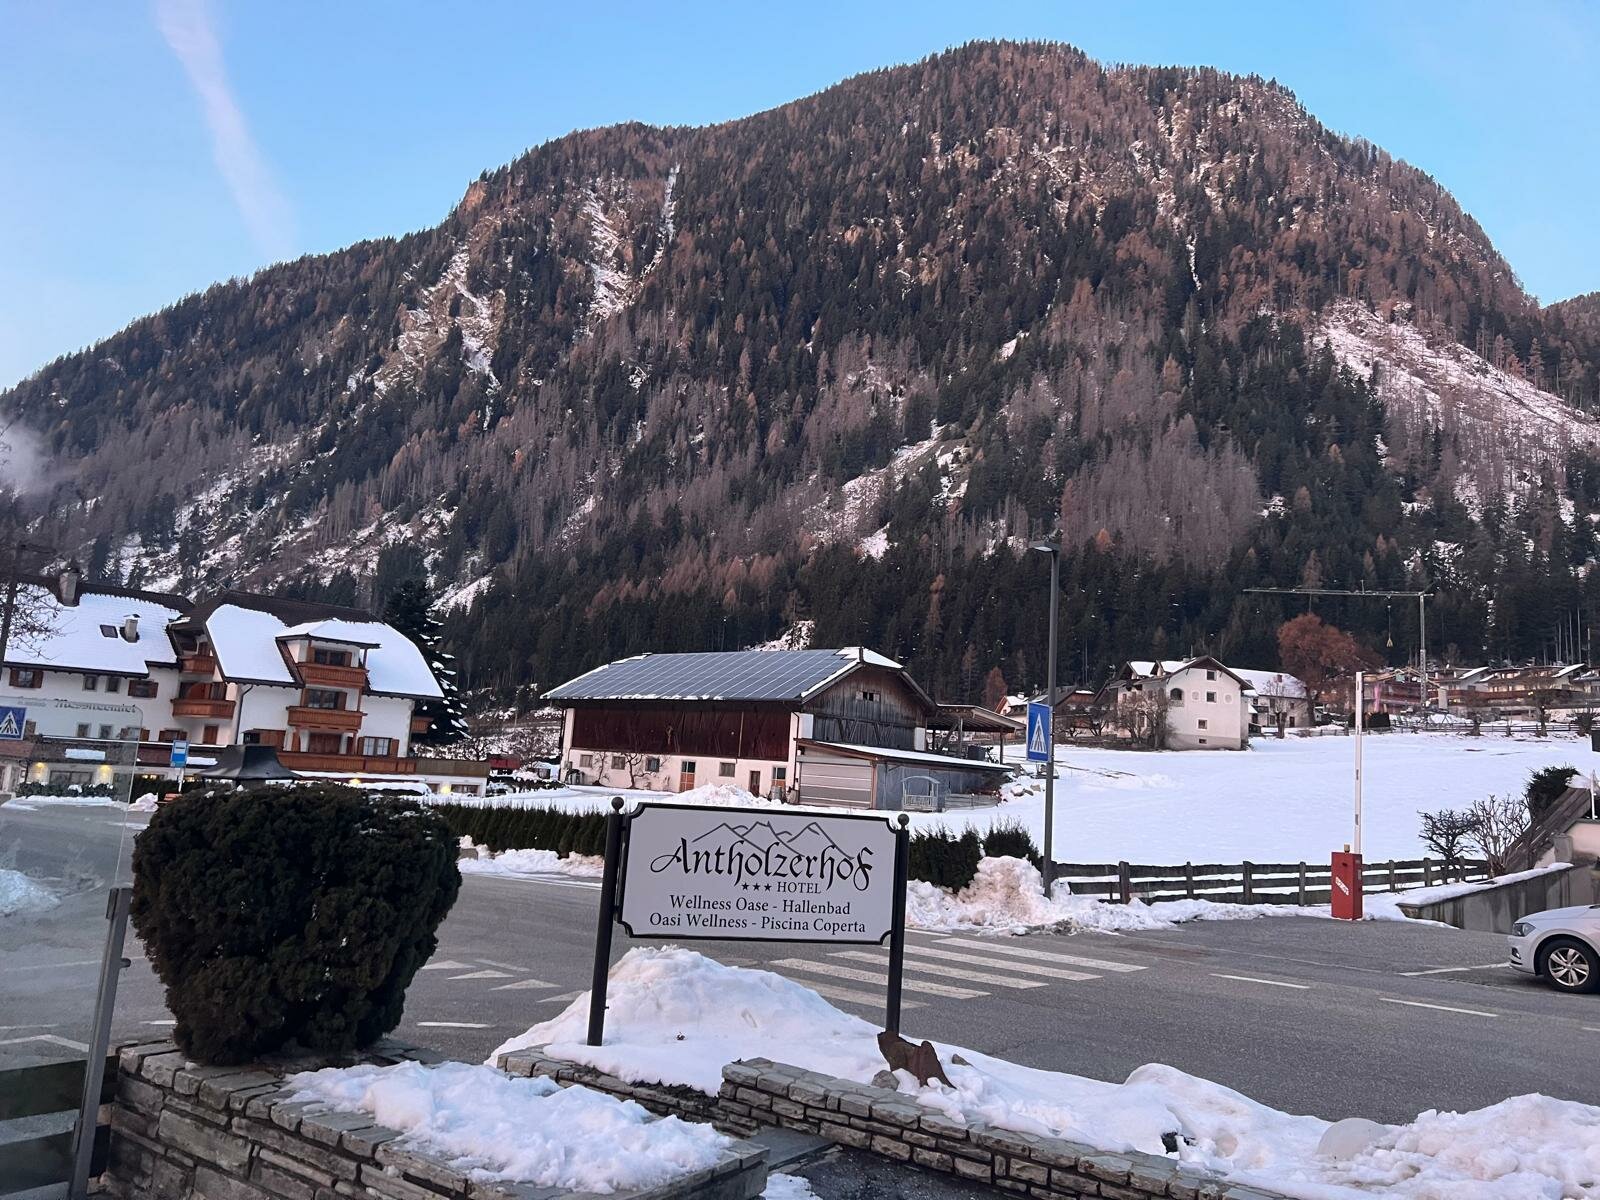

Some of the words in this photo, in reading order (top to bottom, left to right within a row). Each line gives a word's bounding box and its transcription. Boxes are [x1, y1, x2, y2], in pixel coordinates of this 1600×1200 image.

[650, 837, 874, 891] Antholzerhof
[777, 882, 822, 895] HOTEL
[669, 894, 732, 911] Wellness
[736, 897, 769, 912] Oase
[782, 899, 851, 915] Hallenbad
[649, 912, 681, 927] Oasi
[686, 913, 748, 929] Wellness
[761, 916, 809, 931] Piscina
[813, 917, 866, 936] Coperta
